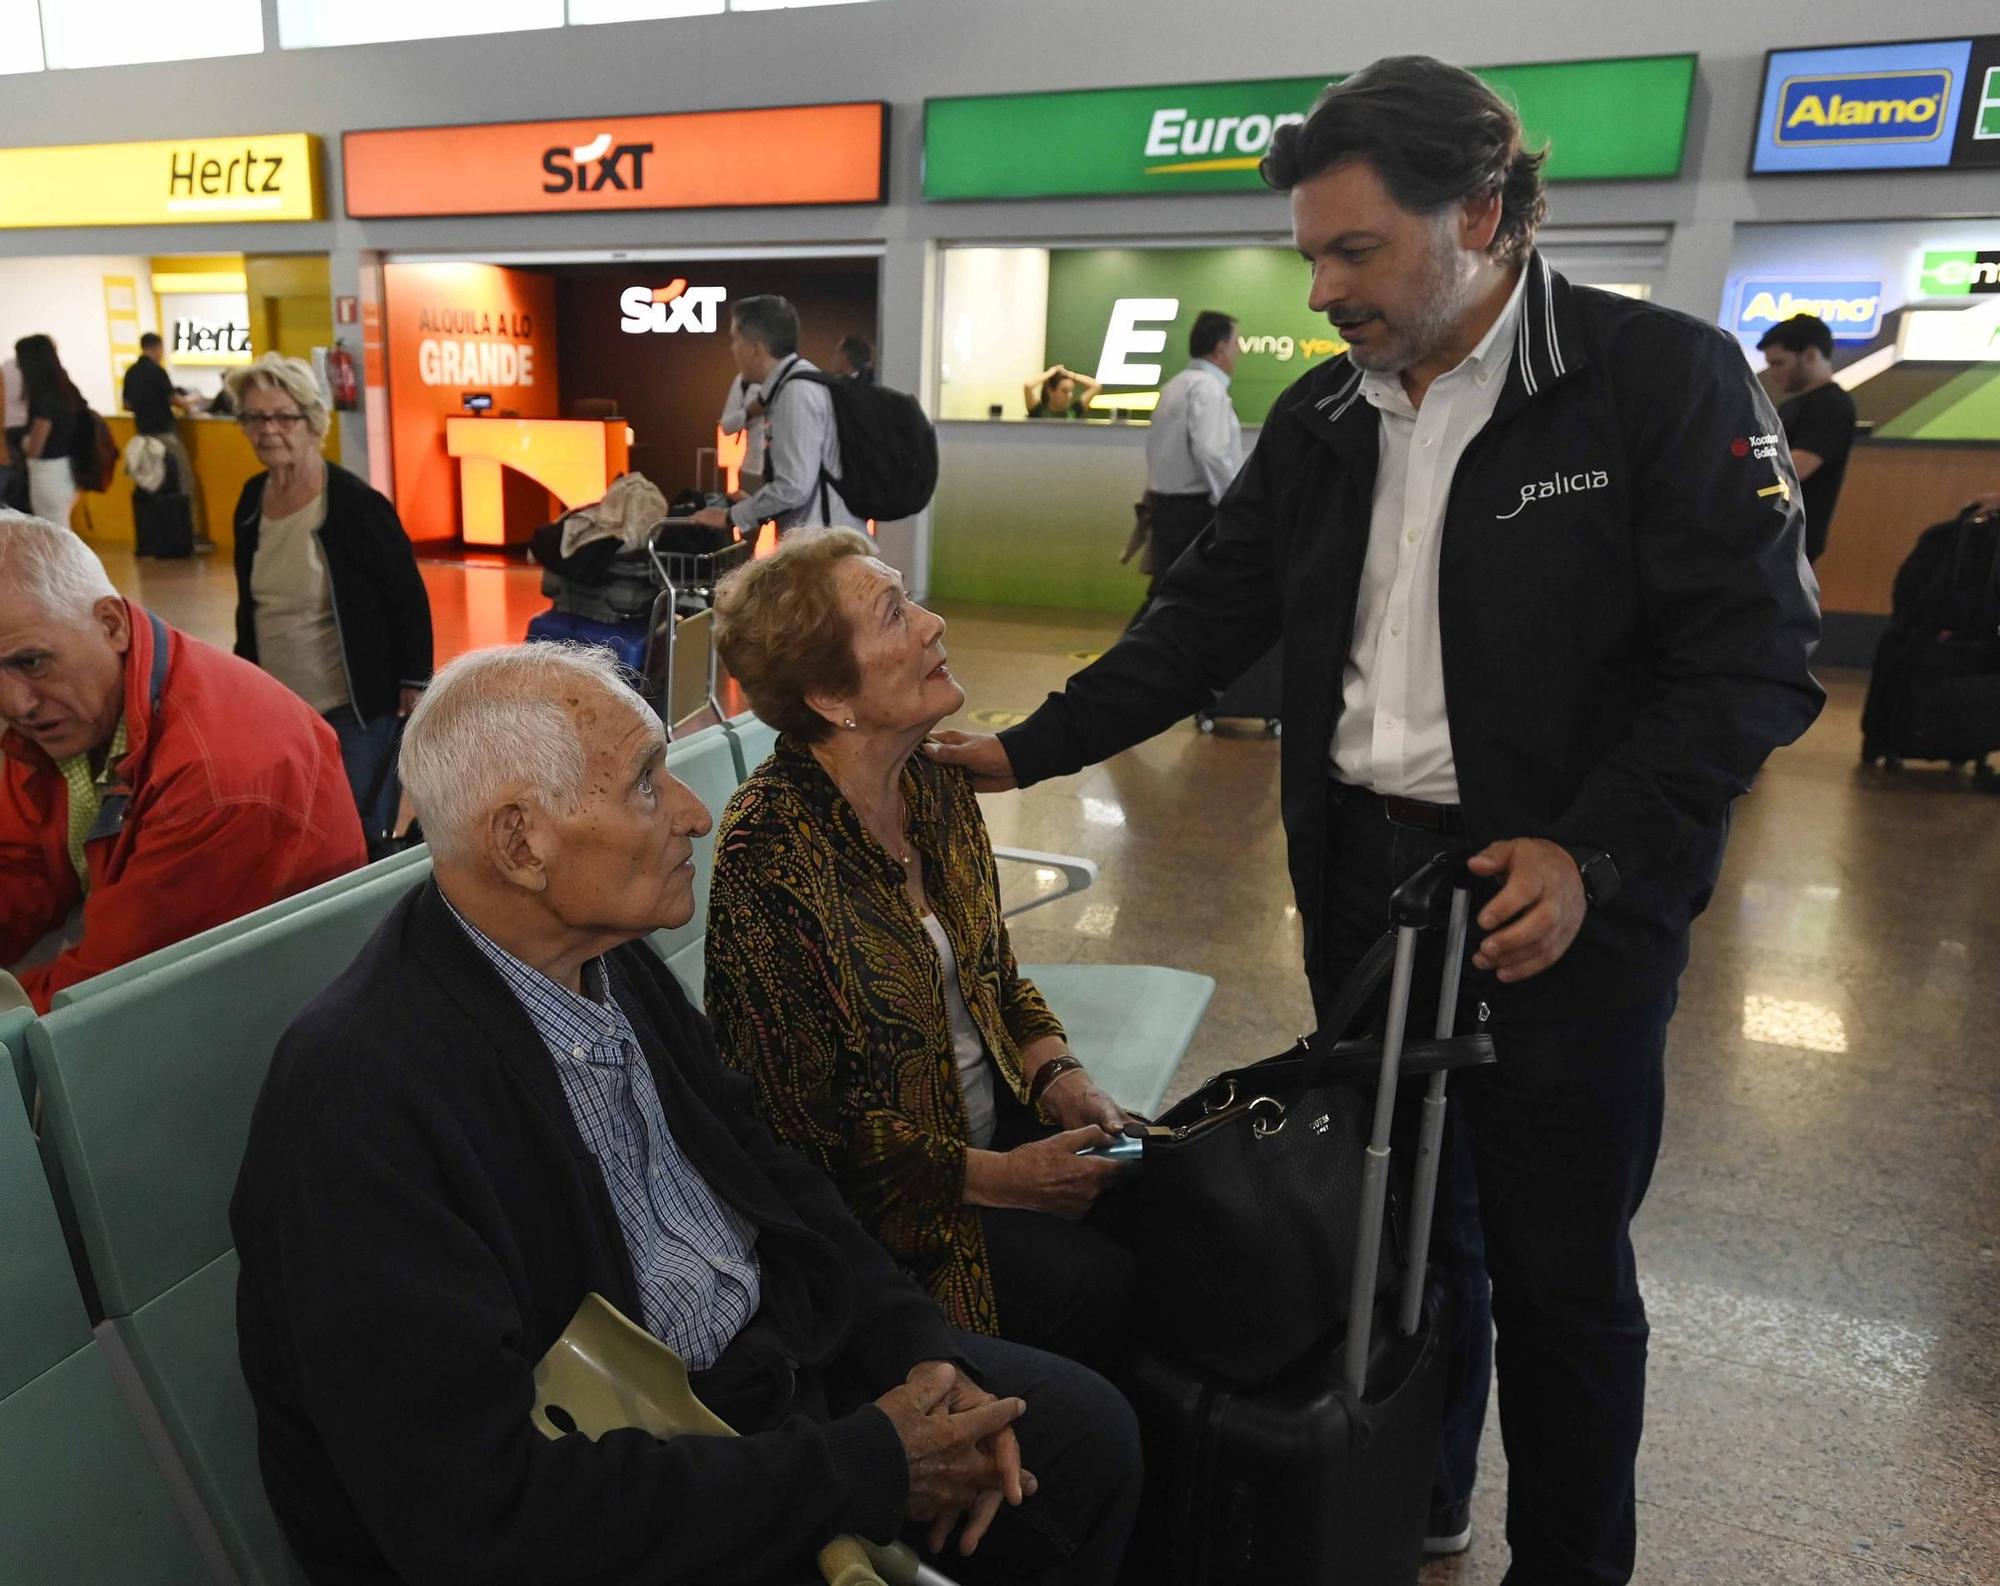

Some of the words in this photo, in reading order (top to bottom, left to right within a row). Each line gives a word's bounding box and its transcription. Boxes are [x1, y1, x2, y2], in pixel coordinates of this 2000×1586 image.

[1786, 94, 1938, 127] Alamo
[170, 150, 282, 195] Hertz
[1930, 260, 2000, 285] en
[1741, 291, 1877, 323] Alamo
[174, 320, 251, 351] Hertz
[419, 309, 490, 334] ALQUILA
[498, 313, 508, 335] A
[512, 314, 531, 338] LO
[1096, 298, 1179, 385] E
[1237, 335, 1294, 361] ving
[418, 339, 534, 386] GRANDE
[1496, 470, 1609, 519] galicia
